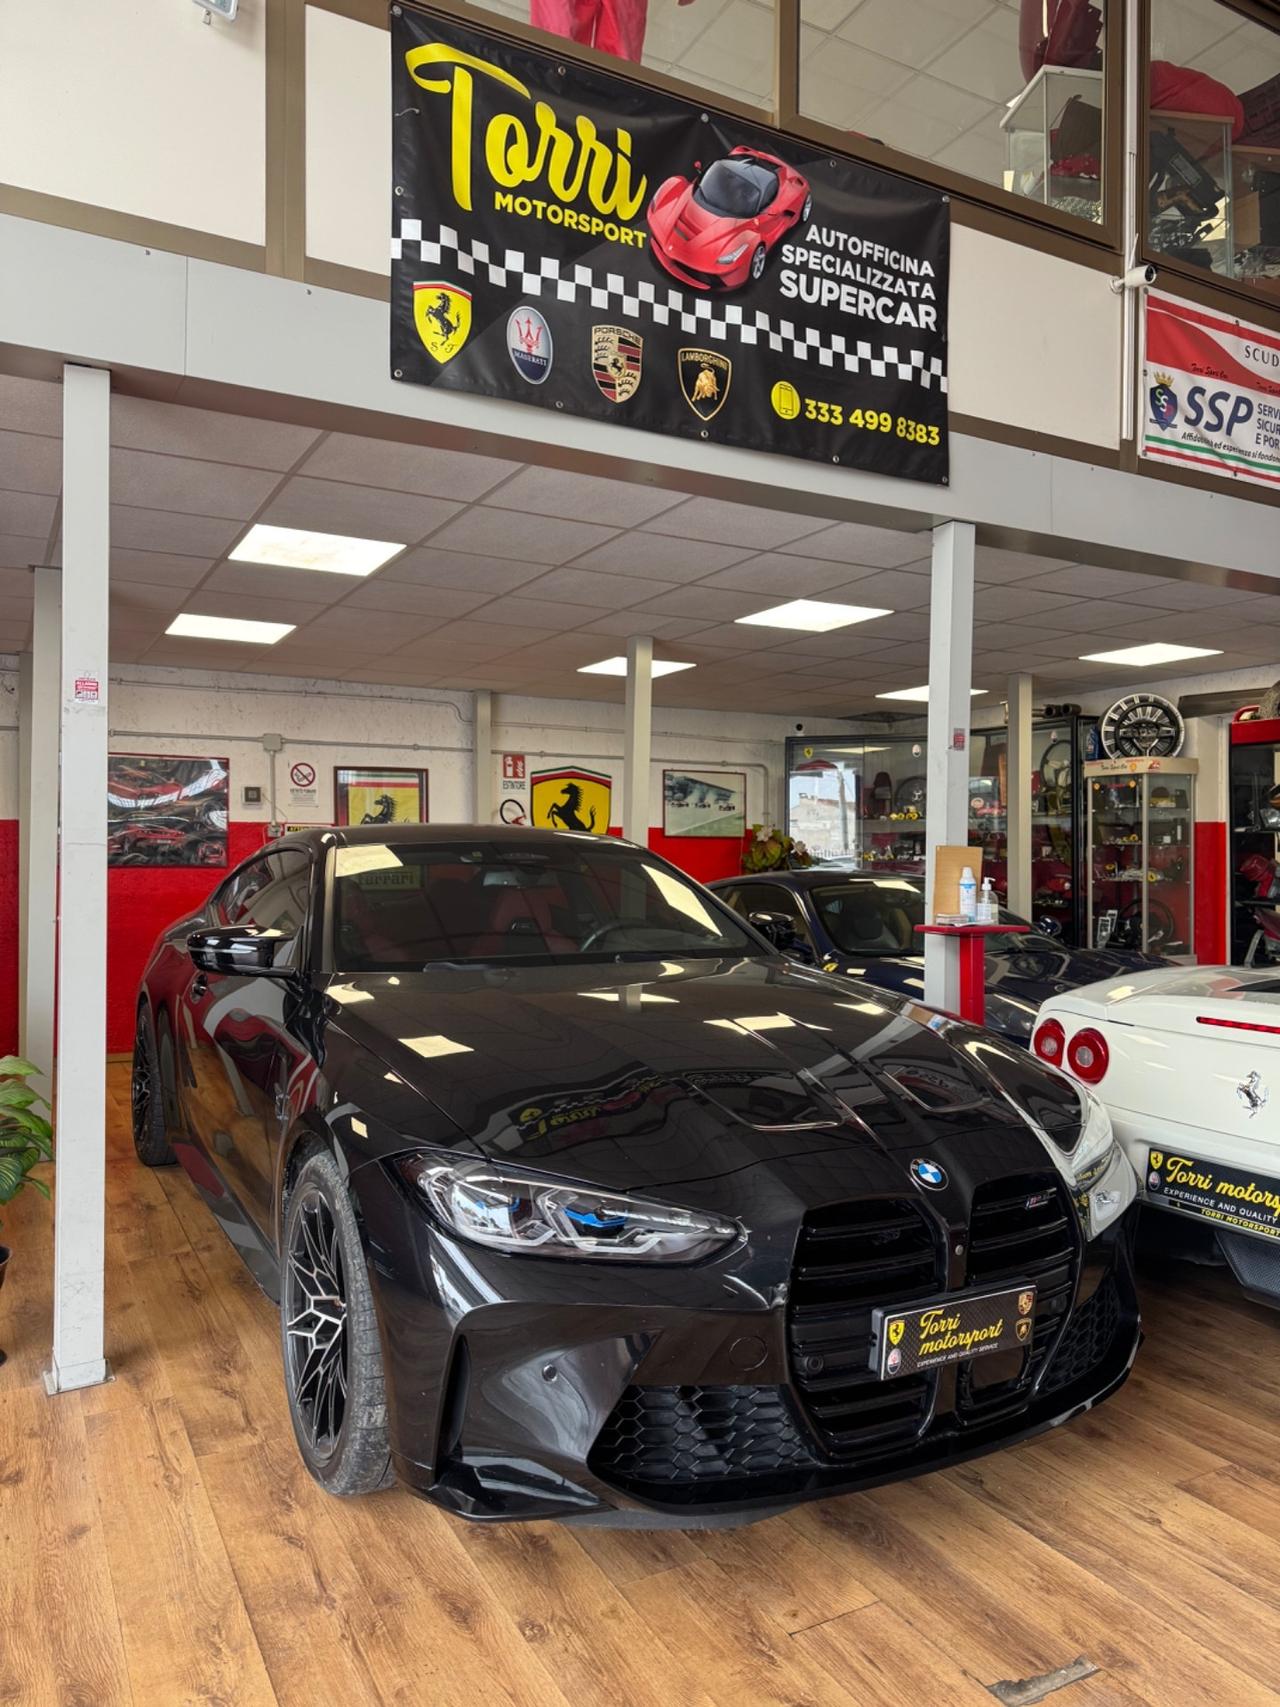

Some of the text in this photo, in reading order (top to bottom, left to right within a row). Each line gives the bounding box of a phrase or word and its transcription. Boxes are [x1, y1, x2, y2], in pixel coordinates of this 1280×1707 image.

[405, 42, 647, 221] Torri
[494, 191, 647, 248] MOTORSPORT
[805, 224, 935, 277] AUTOFFICINA
[781, 244, 936, 301] SPECIALIZZATA
[779, 269, 937, 332] SUPERCAR
[593, 326, 642, 346] PORSCHE
[513, 350, 548, 367] MASERATI
[681, 351, 729, 371] LAMBORGHINI
[804, 398, 941, 446] 333 499 8383
[1184, 386, 1254, 437] SSP
[1255, 432, 1262, 445] E
[1166, 1157, 1213, 1190] Torri
[1164, 1187, 1278, 1224] EXPERIENCE AND QUALITY
[1201, 1208, 1224, 1220] TORRI
[918, 1319, 1003, 1356] motorsport
[919, 1309, 960, 1339] Torri
[916, 1355, 946, 1368] EXPERIENCE
[947, 1352, 958, 1360] AND
